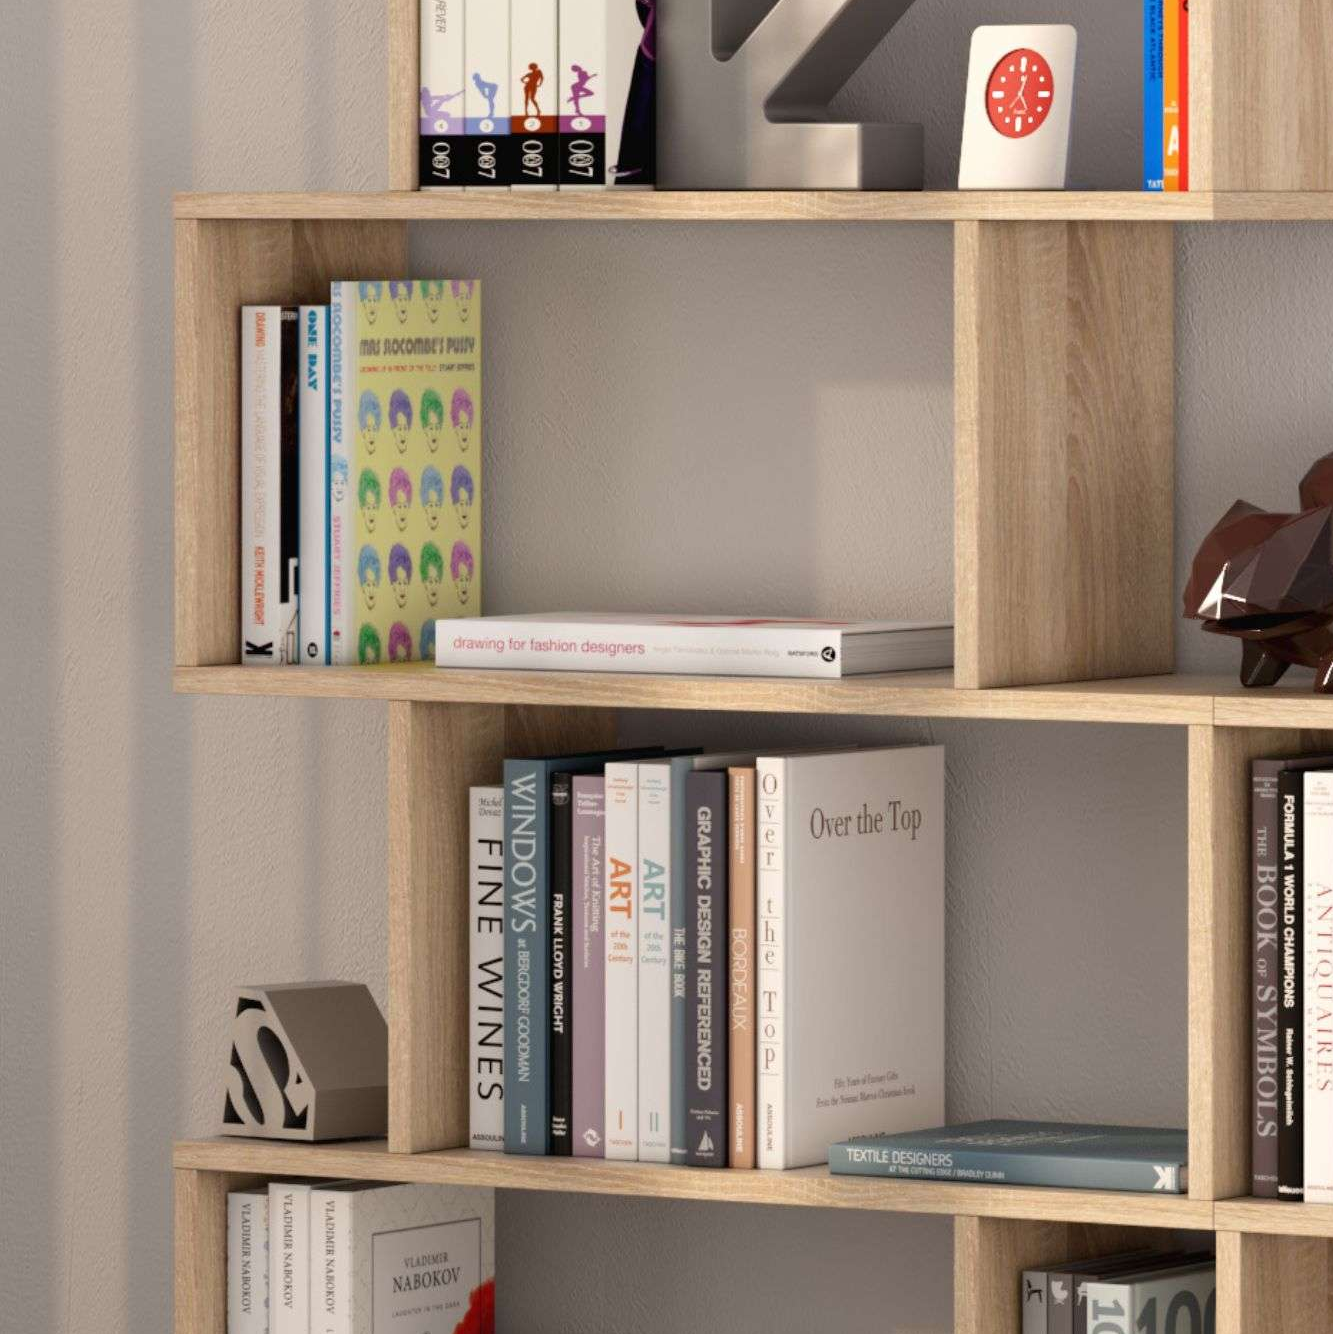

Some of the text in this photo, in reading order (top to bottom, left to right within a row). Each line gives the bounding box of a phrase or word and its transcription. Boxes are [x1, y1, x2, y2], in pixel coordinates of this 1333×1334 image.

[307, 309, 318, 391] ONE DAY
[453, 636, 505, 653] drawing
[507, 637, 526, 652] for
[529, 638, 577, 653] fashion
[581, 640, 646, 658] designers
[511, 772, 537, 933] WINDOWS
[697, 805, 713, 890] GRAPHIC
[810, 800, 922, 841] Over the Top
[1256, 827, 1267, 858] THE
[1283, 794, 1296, 861] FORMULA
[609, 857, 633, 920] ART
[642, 858, 666, 921] ART
[762, 773, 778, 1070] Over the Top
[1256, 865, 1278, 953] BOOK
[1283, 874, 1296, 925] WORLD
[477, 838, 504, 1100] FINE WINES
[552, 893, 564, 1035] FRANK LLOYD WRIGHT
[697, 895, 713, 965] DESIGN
[1283, 927, 1296, 1009] CHAMPIONS
[732, 928, 748, 1031] BORDEAUX
[1313, 883, 1333, 1092] ANTIQUAIRES
[697, 969, 713, 1092] REFERENCED
[1256, 984, 1278, 1138] SYMBOLS
[846, 1147, 953, 1167] TEXTILE DESIGNERS
[241, 1203, 252, 1316] VLADIMIR NABOKOV
[283, 1193, 294, 1309] VLADIMIR NABOKOV
[325, 1200, 336, 1256] VLADIMIR
[403, 1252, 449, 1268] VLADIMIR
[325, 1257, 336, 1315] NABOKOV
[392, 1267, 461, 1293] NABOKOV
